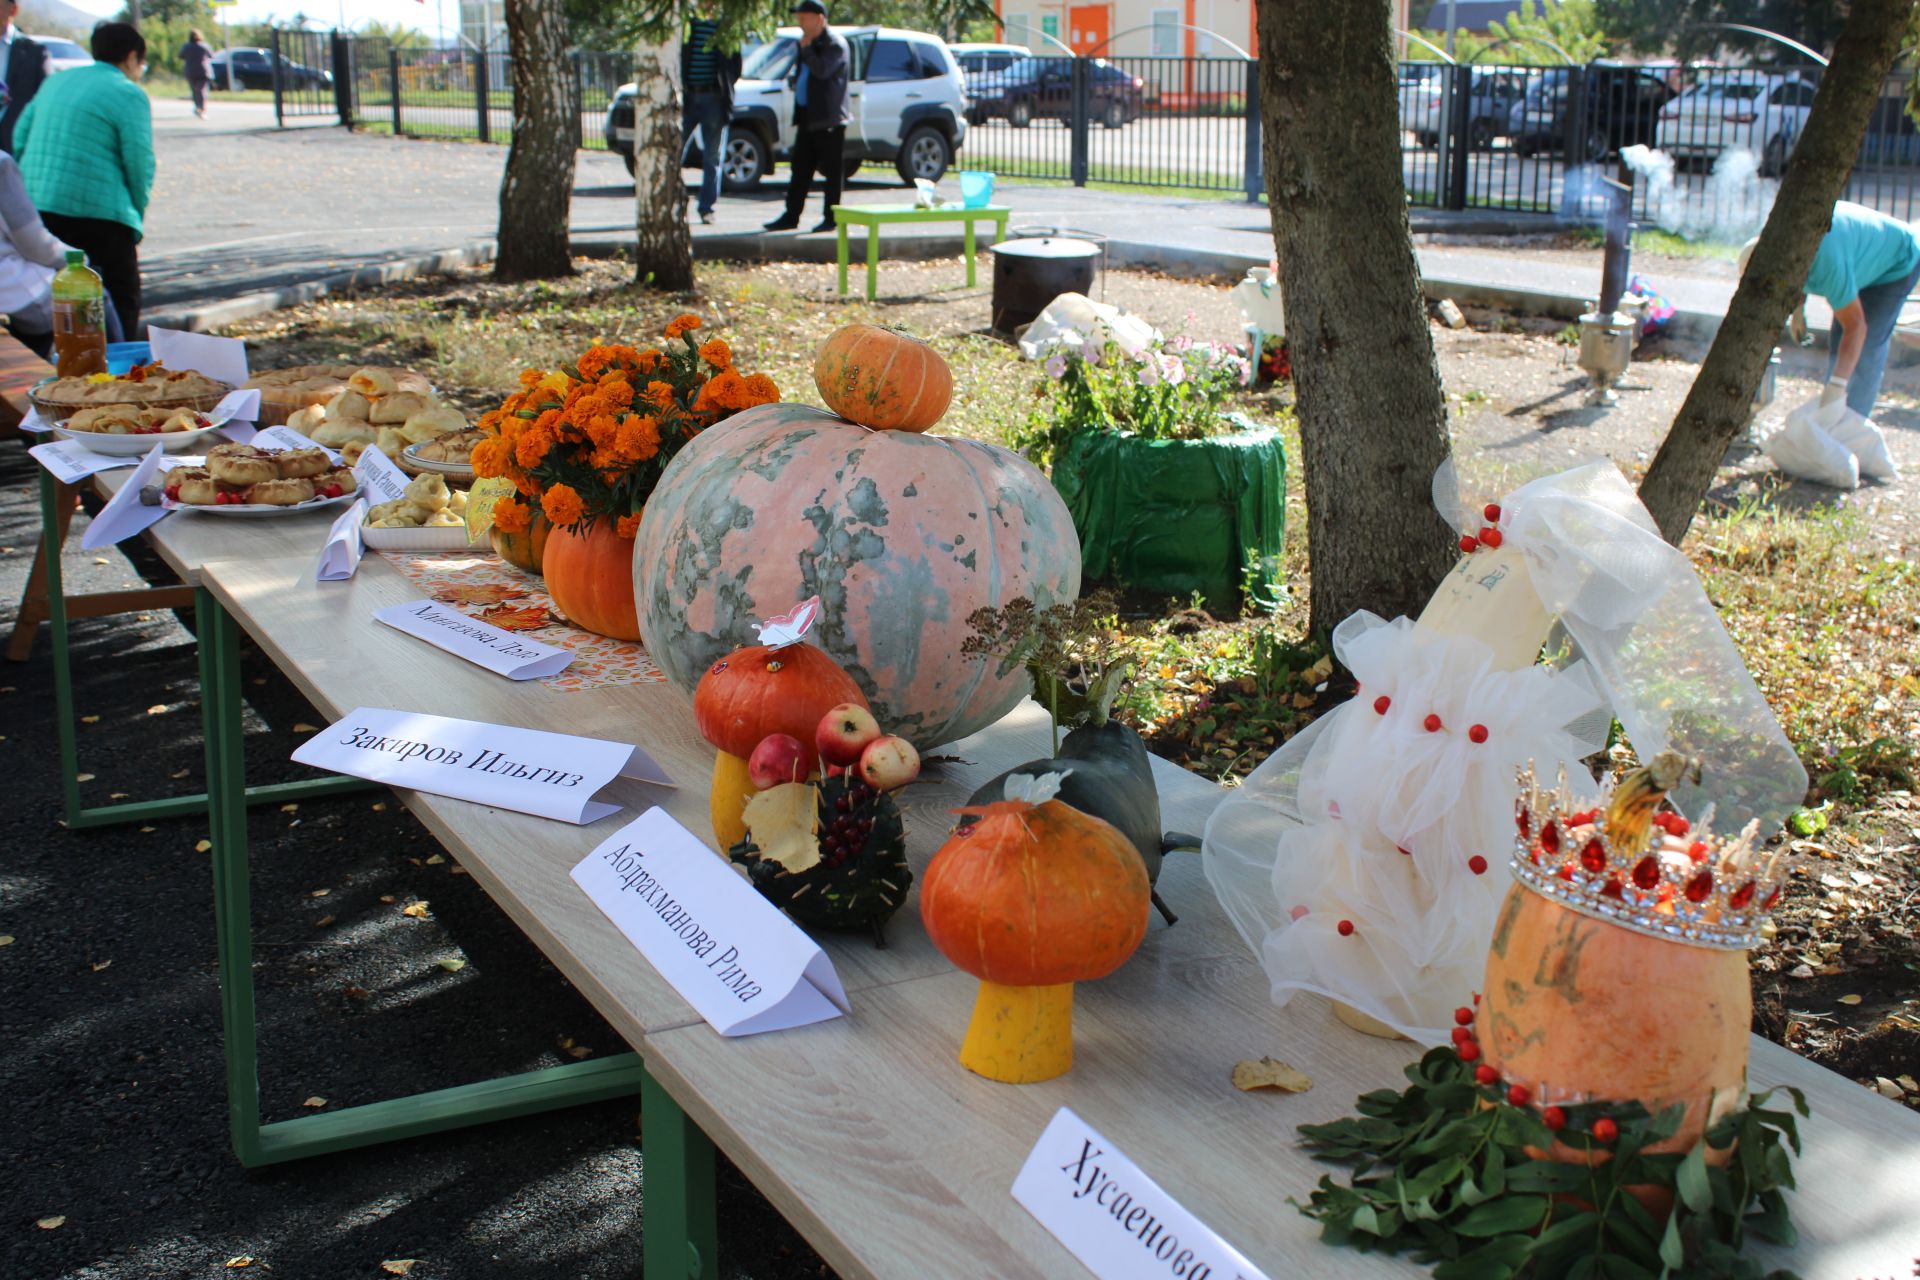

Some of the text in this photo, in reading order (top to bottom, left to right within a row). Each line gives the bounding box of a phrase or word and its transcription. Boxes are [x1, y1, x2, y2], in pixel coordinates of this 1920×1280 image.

[339, 726, 585, 788] Закиров Ильгиз
[603, 843, 764, 1004] Абдрахманова Рима
